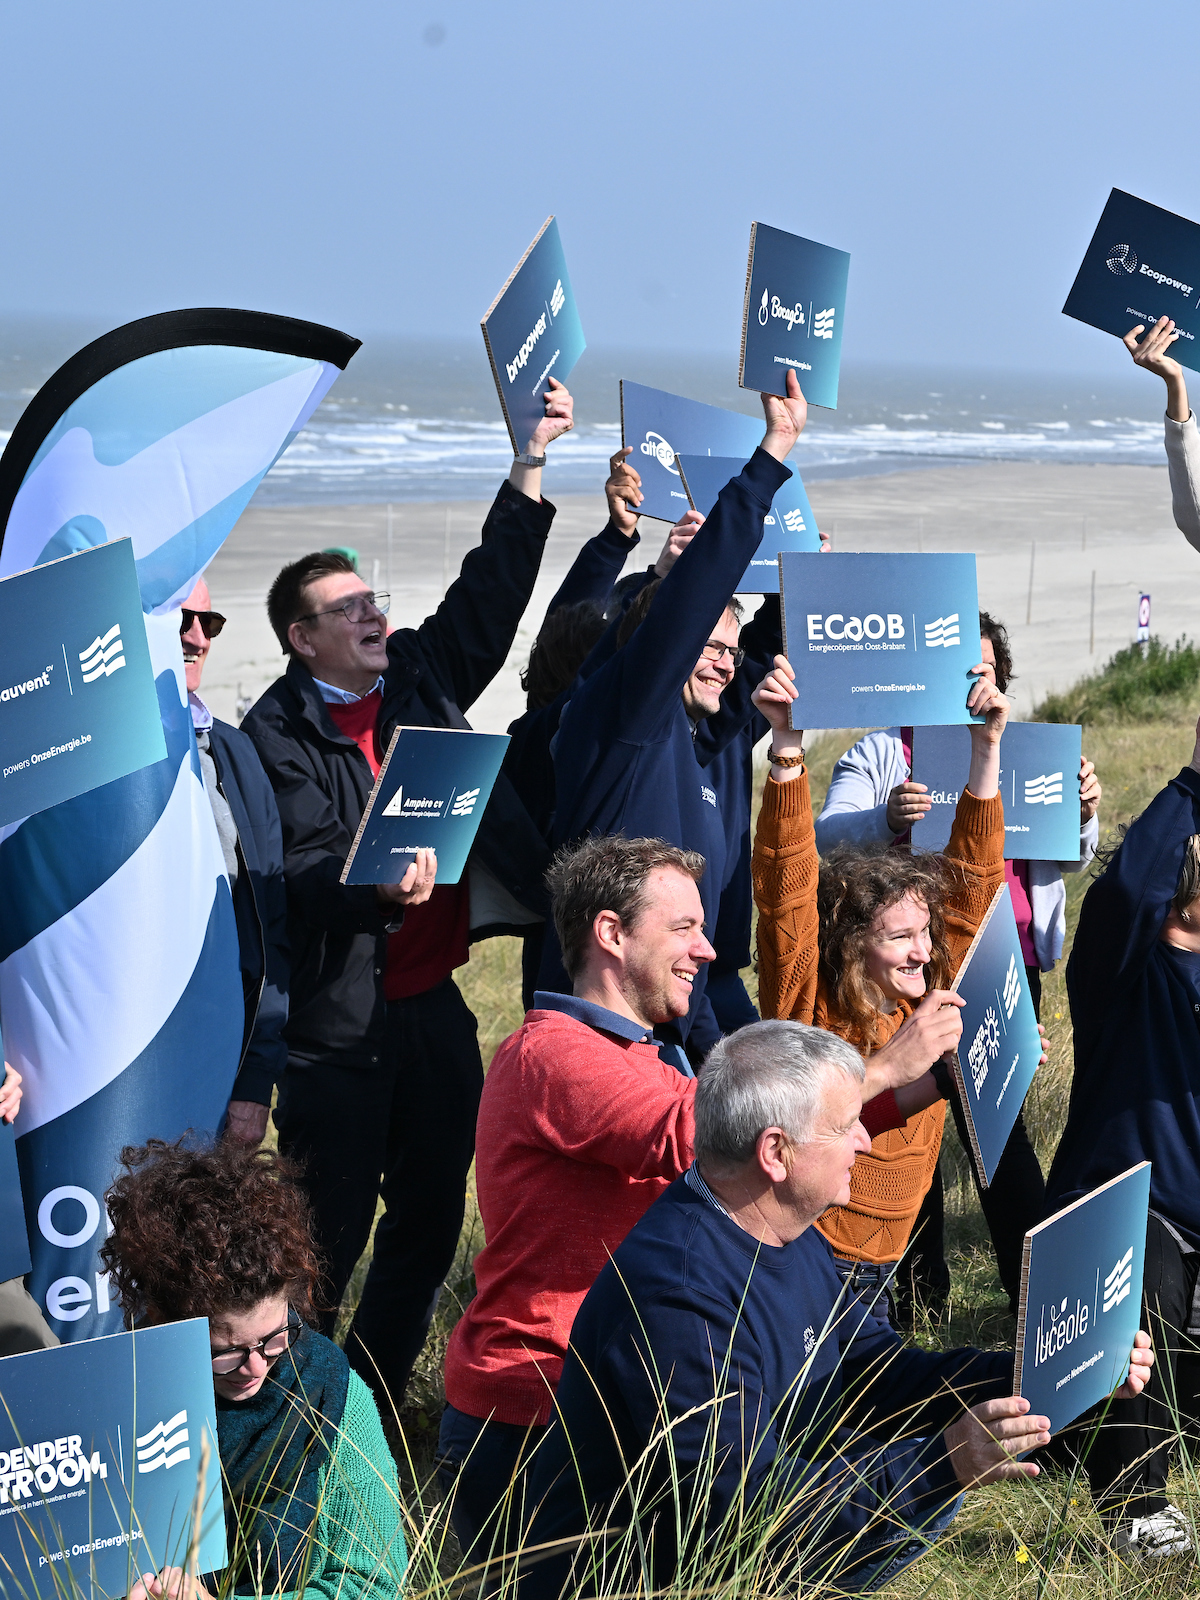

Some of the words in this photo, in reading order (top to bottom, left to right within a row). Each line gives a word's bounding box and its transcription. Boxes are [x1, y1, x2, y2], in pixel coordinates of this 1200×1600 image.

[1138, 262, 1194, 294] Ecopower
[770, 295, 805, 332] BocagEn
[1125, 307, 1148, 320] powers
[505, 311, 547, 384] brupower
[808, 642, 864, 653] Energiecoöperatie
[864, 642, 906, 651] Oost-Brabant
[0, 671, 51, 702] auvent
[851, 685, 874, 694] powers
[874, 683, 926, 693] OnzeEnergie.be
[2, 758, 31, 778] powers
[30, 733, 92, 765] OnzeEnergie.be
[403, 797, 433, 811] Ampère
[967, 1023, 986, 1068] mega
[974, 1055, 989, 1101] puur
[1055, 1372, 1071, 1392] powers
[0, 1451, 108, 1504] TROOM
[27, 1501, 33, 1509] in
[67, 1488, 87, 1499] energie.
